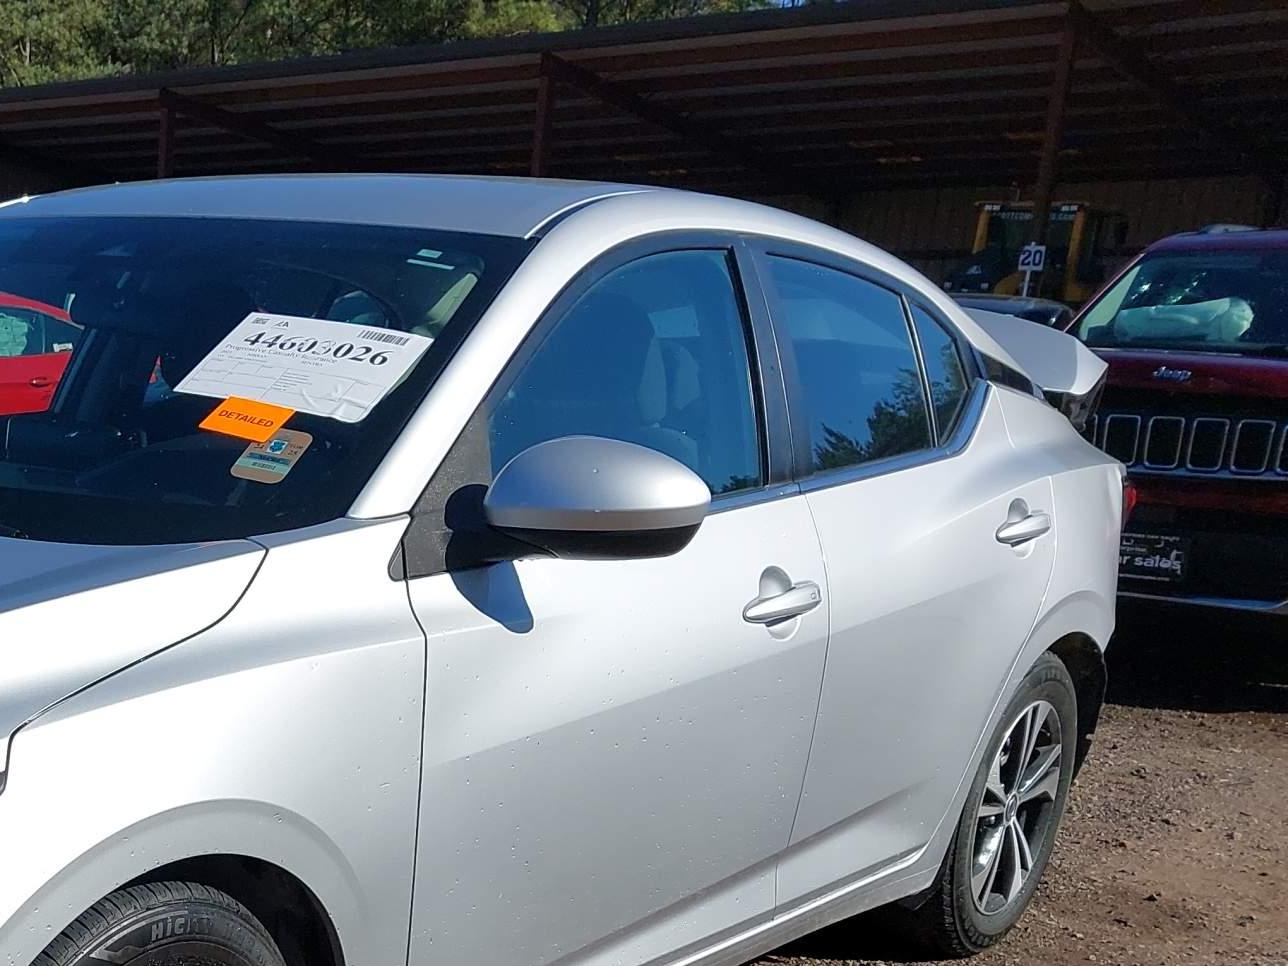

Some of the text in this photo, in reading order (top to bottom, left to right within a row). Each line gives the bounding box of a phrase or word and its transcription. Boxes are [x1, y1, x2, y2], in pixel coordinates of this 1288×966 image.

[1020, 249, 1043, 266] 20
[244, 331, 394, 366] 44603026
[1152, 366, 1192, 382] Jeep
[218, 409, 274, 428] DETAILED
